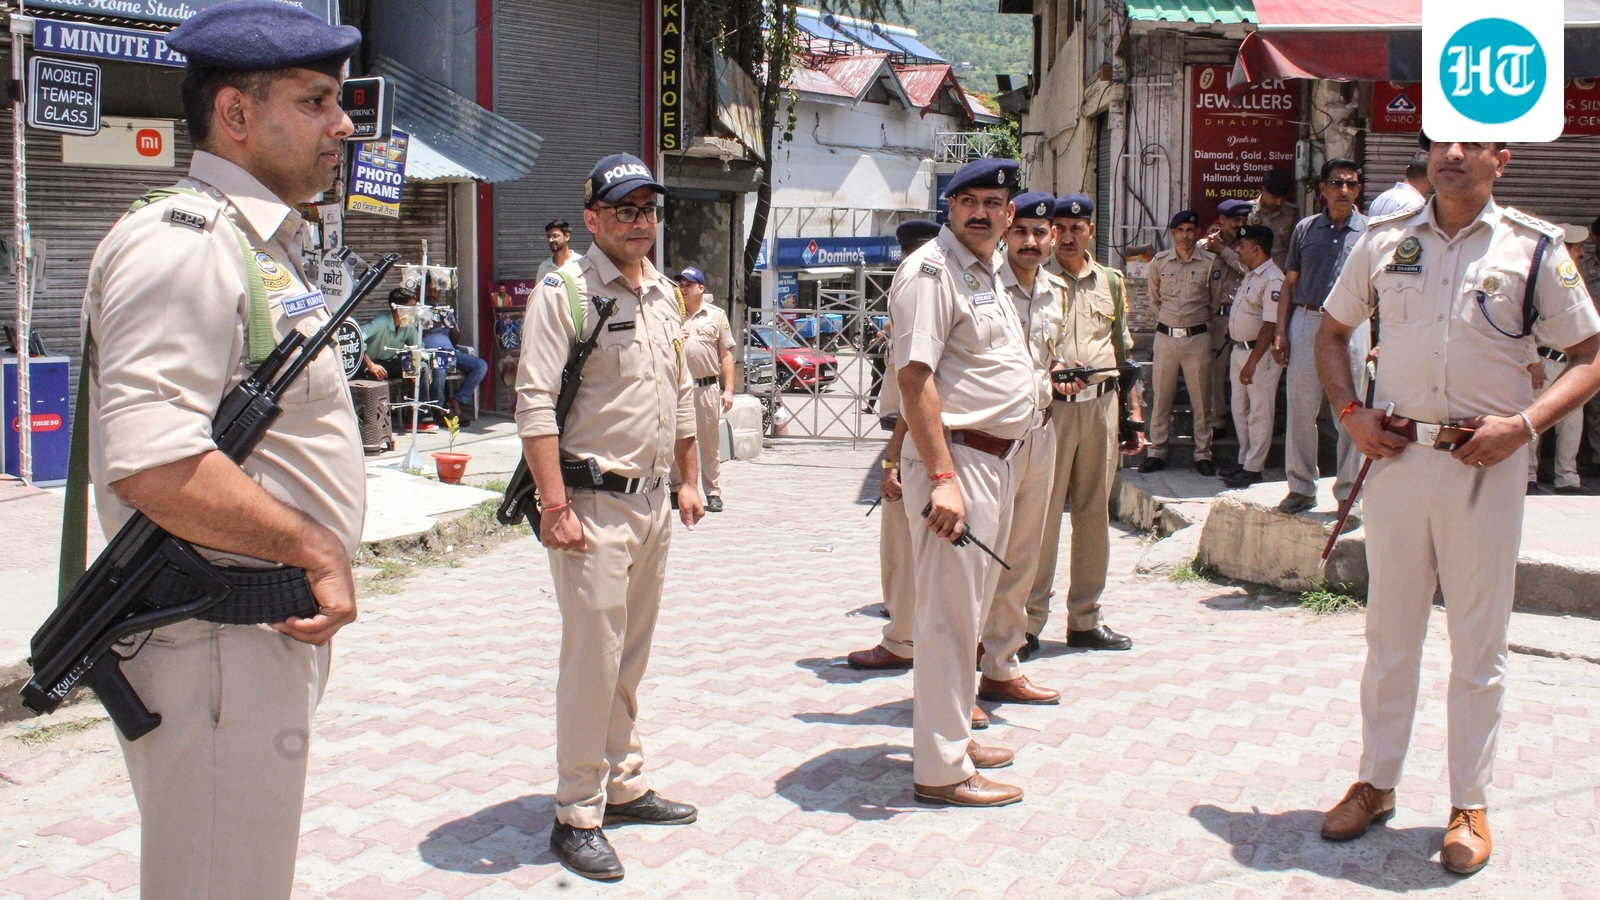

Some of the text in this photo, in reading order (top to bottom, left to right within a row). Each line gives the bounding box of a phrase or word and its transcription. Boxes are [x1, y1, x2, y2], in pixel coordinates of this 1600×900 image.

[43, 25, 187, 63] 1 MINUTE PA
[41, 67, 94, 87] MOBILE
[662, 3, 679, 149] KA SHOES
[40, 86, 93, 106] TEMPER
[1196, 93, 1293, 110] JEWLLERS
[44, 105, 88, 124] GLASS
[1194, 150, 1234, 160] Diamond
[1240, 151, 1262, 160] Gold
[1268, 151, 1294, 161] Silver
[356, 165, 402, 186] PHOTO
[603, 163, 650, 185] POLICE
[1214, 162, 1241, 173] Lucky
[1202, 173, 1242, 182] Hallmark
[355, 180, 400, 200] FRAME
[1205, 189, 1218, 197] M.
[818, 247, 865, 264] Domino's
